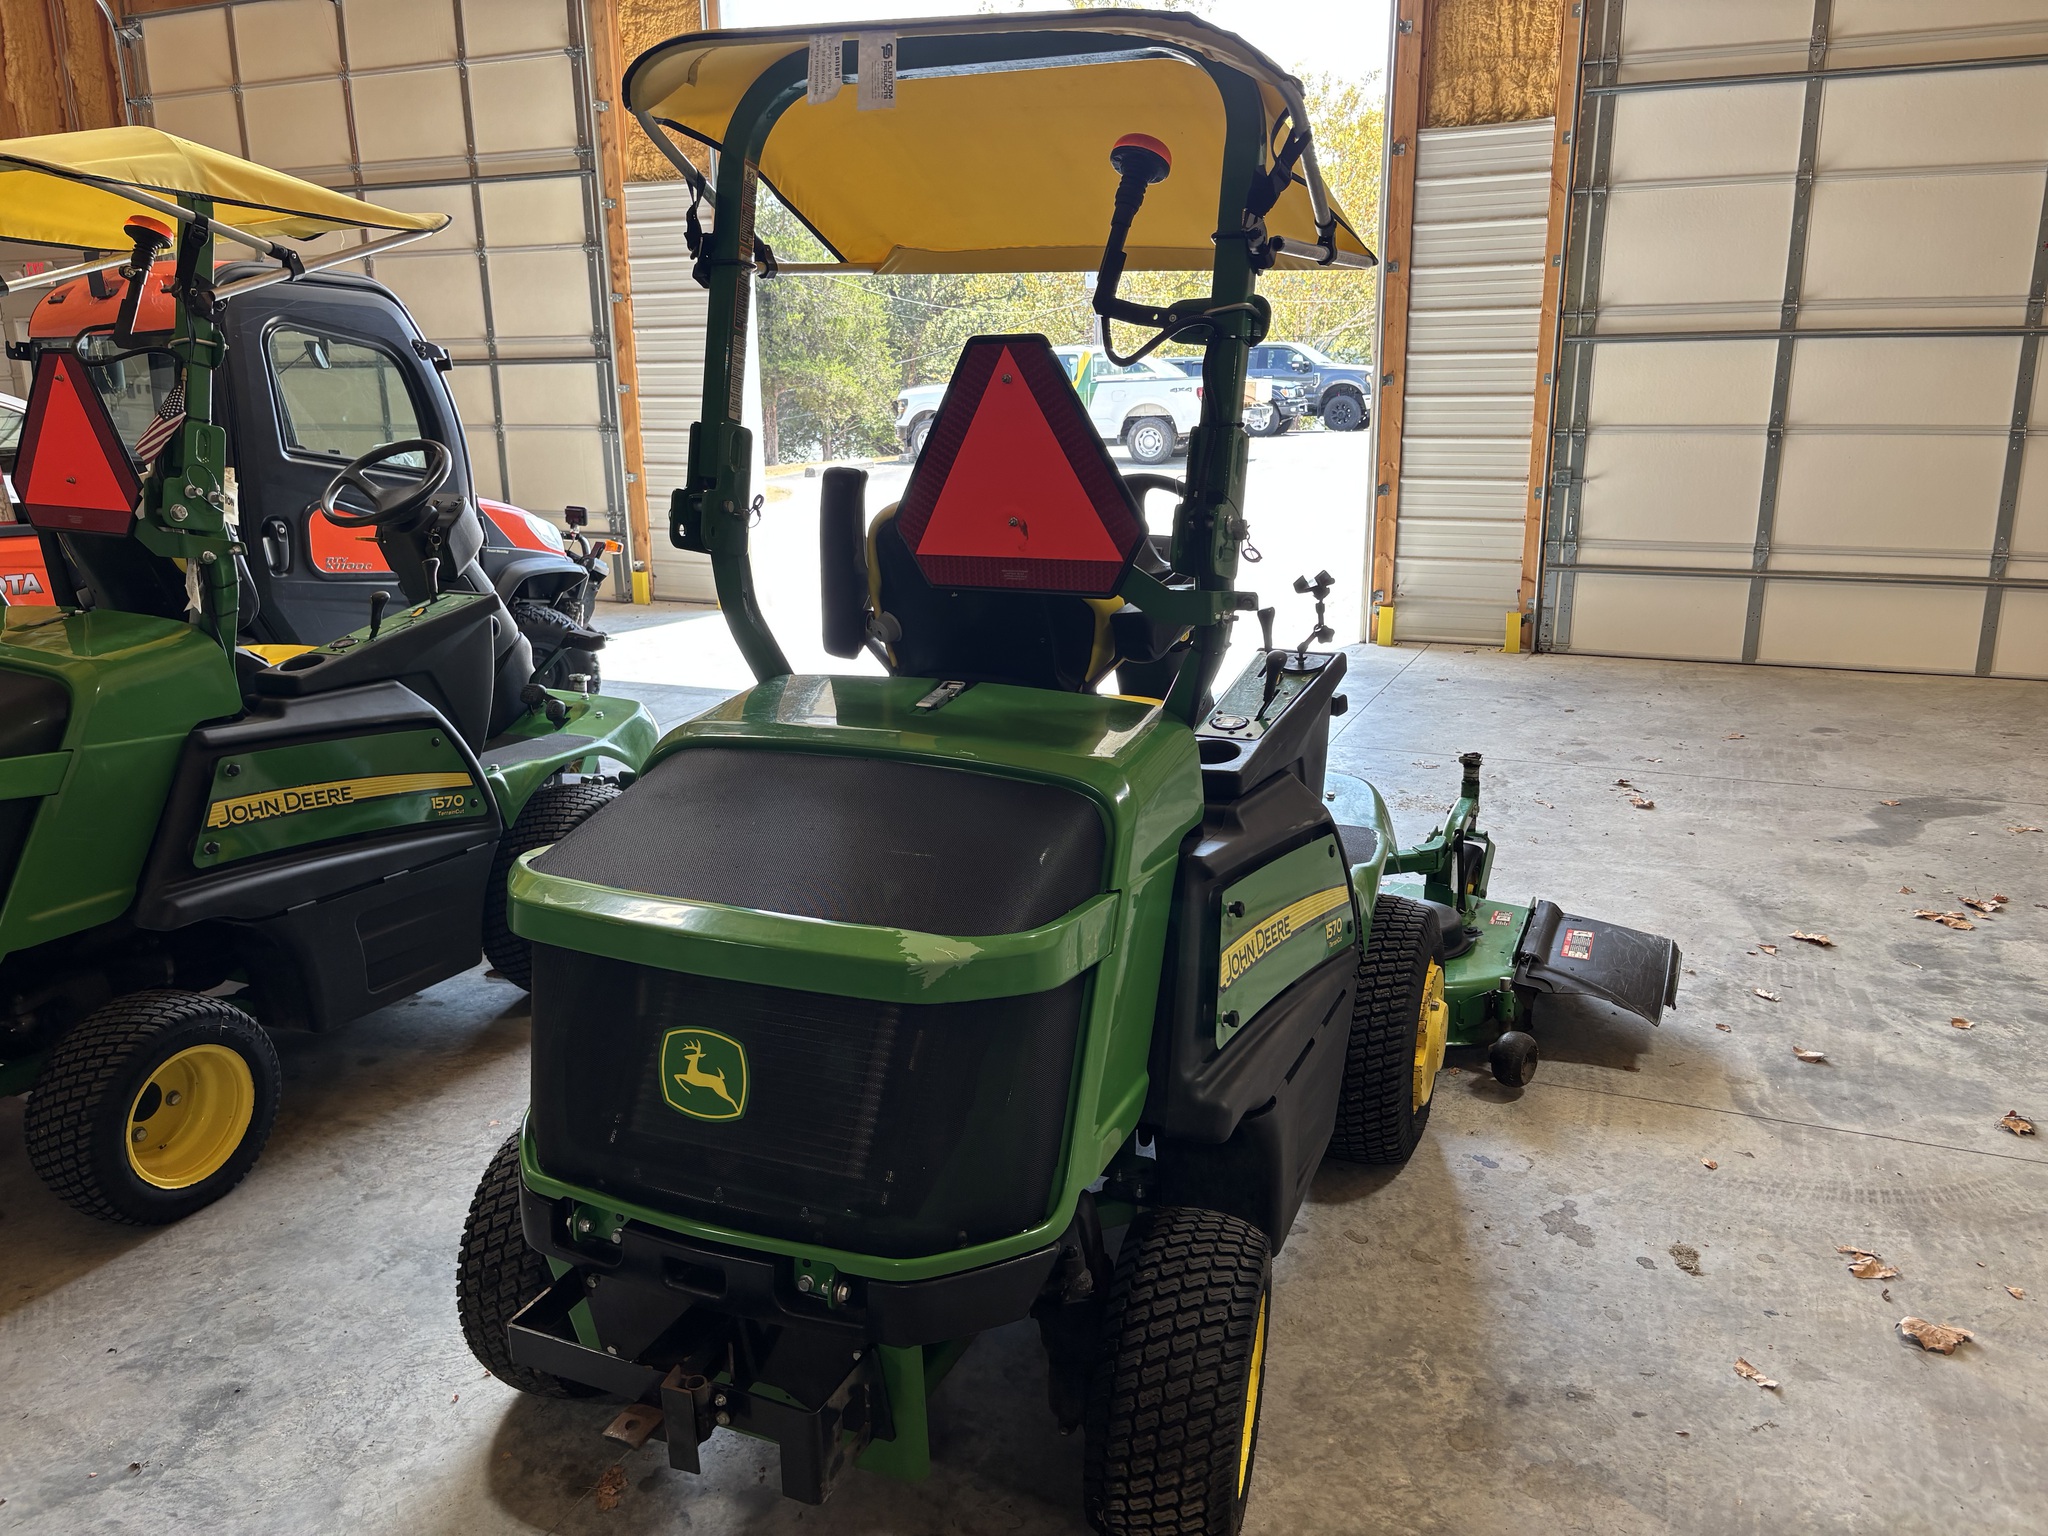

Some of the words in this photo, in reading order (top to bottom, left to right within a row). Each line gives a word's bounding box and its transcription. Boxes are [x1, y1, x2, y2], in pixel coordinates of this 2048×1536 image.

[217, 797, 281, 828] JOHN
[283, 786, 355, 815] DEERE
[431, 794, 465, 810] 1570
[437, 808, 465, 817] TerrainCut
[1325, 917, 1343, 941] 1570
[1226, 938, 1256, 984] JOHN
[1254, 915, 1292, 955] DEERE
